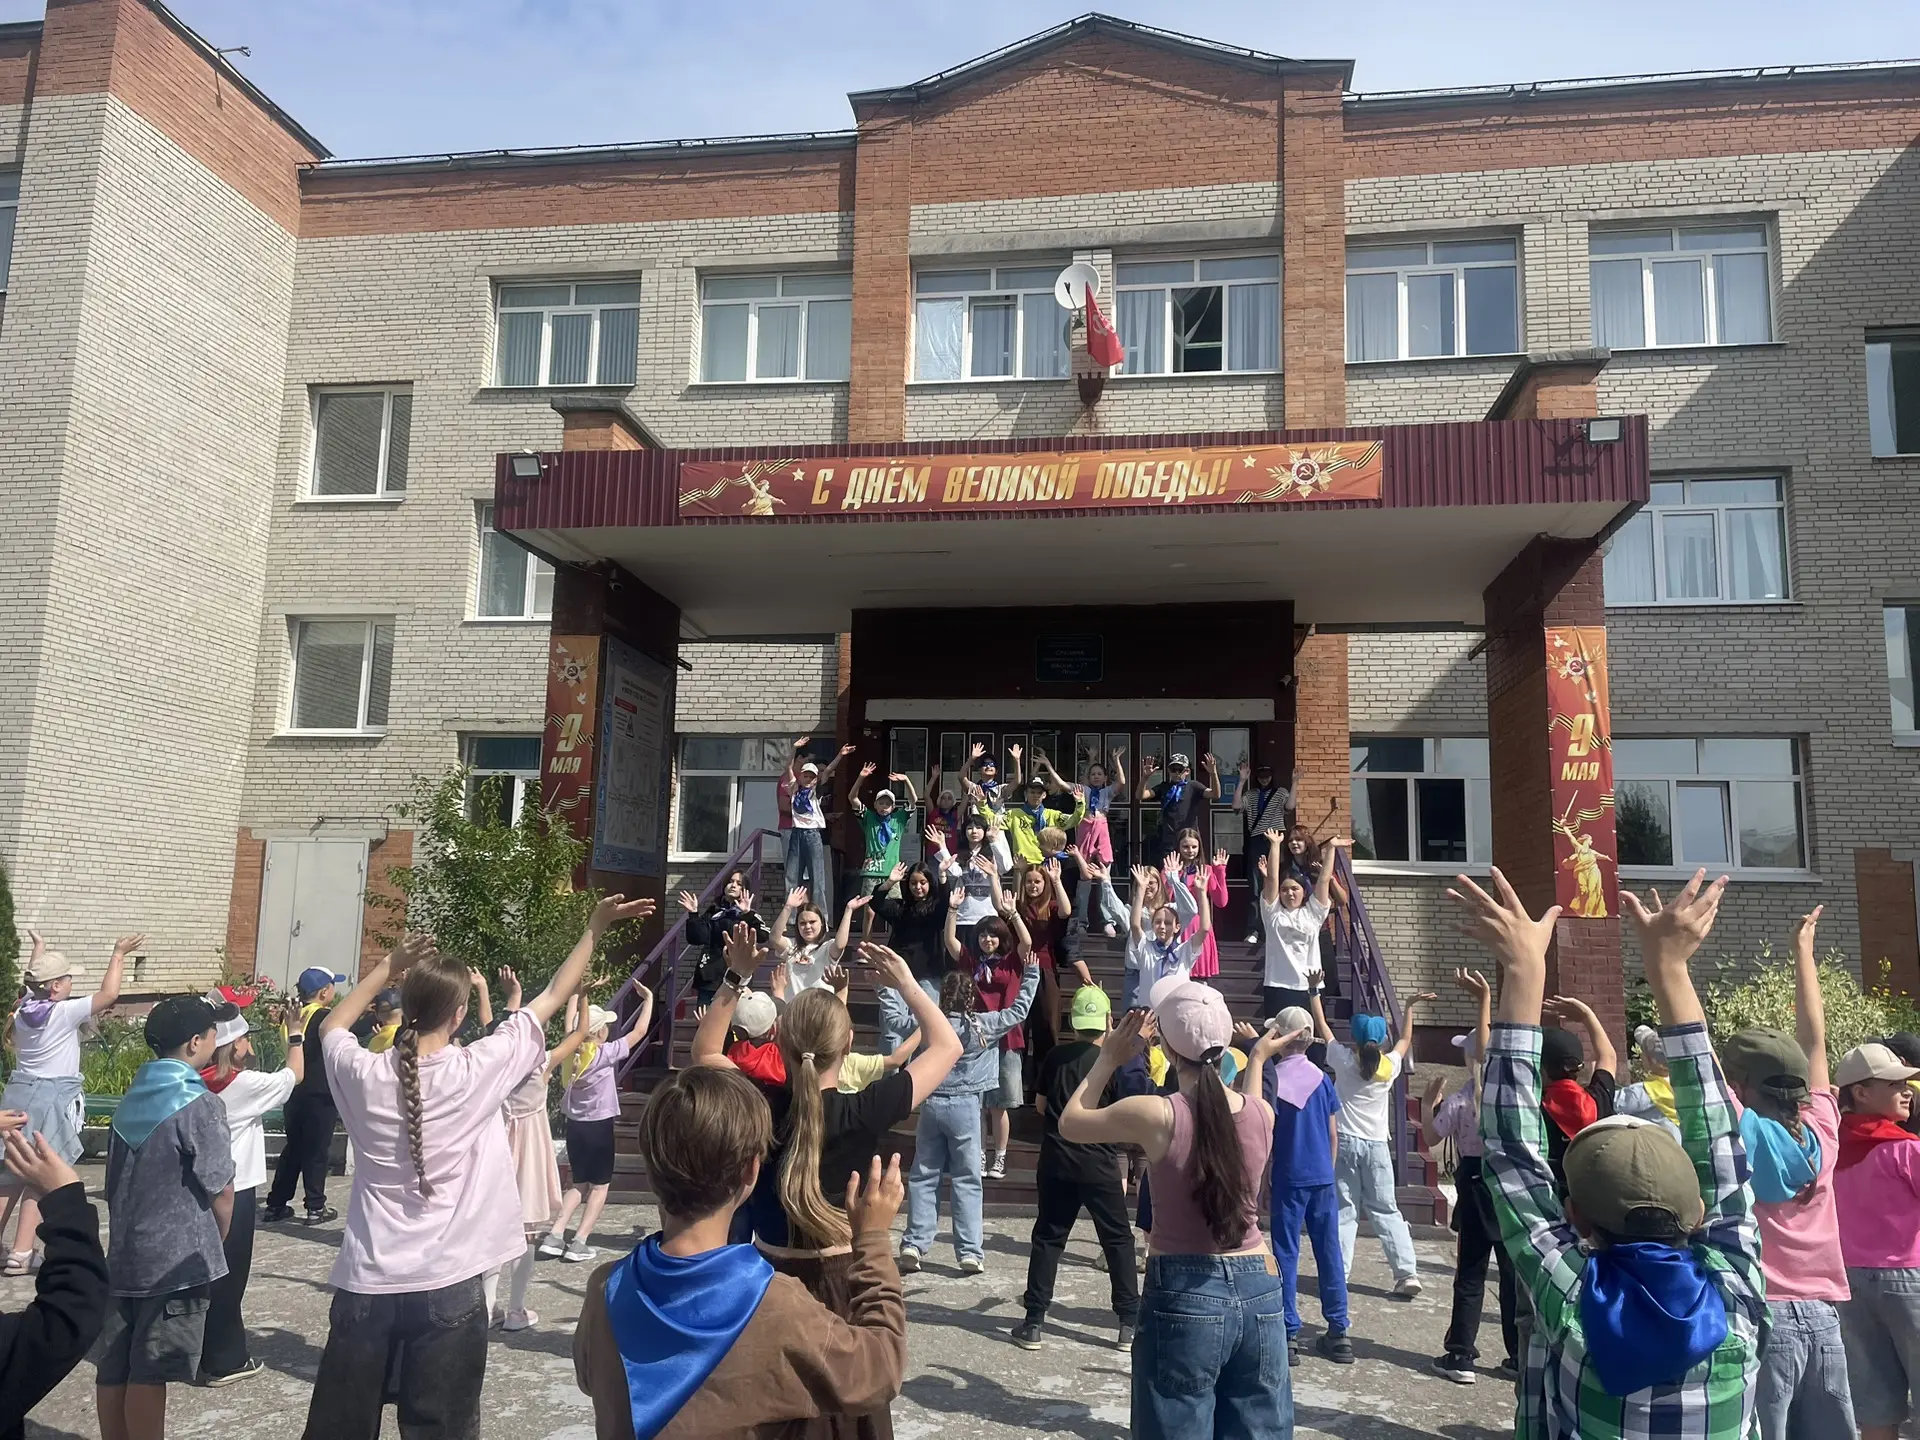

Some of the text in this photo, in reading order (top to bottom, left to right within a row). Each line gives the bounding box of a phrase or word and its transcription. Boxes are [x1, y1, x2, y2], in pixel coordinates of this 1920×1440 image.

[811, 456, 1232, 510] С ДНЁМ ВЕЛИКОЙ ПОБЕДЫ!
[556, 713, 584, 752] 9
[1567, 713, 1596, 757] 9
[548, 756, 582, 774] МАЯ
[1561, 761, 1600, 781] МАЯ
